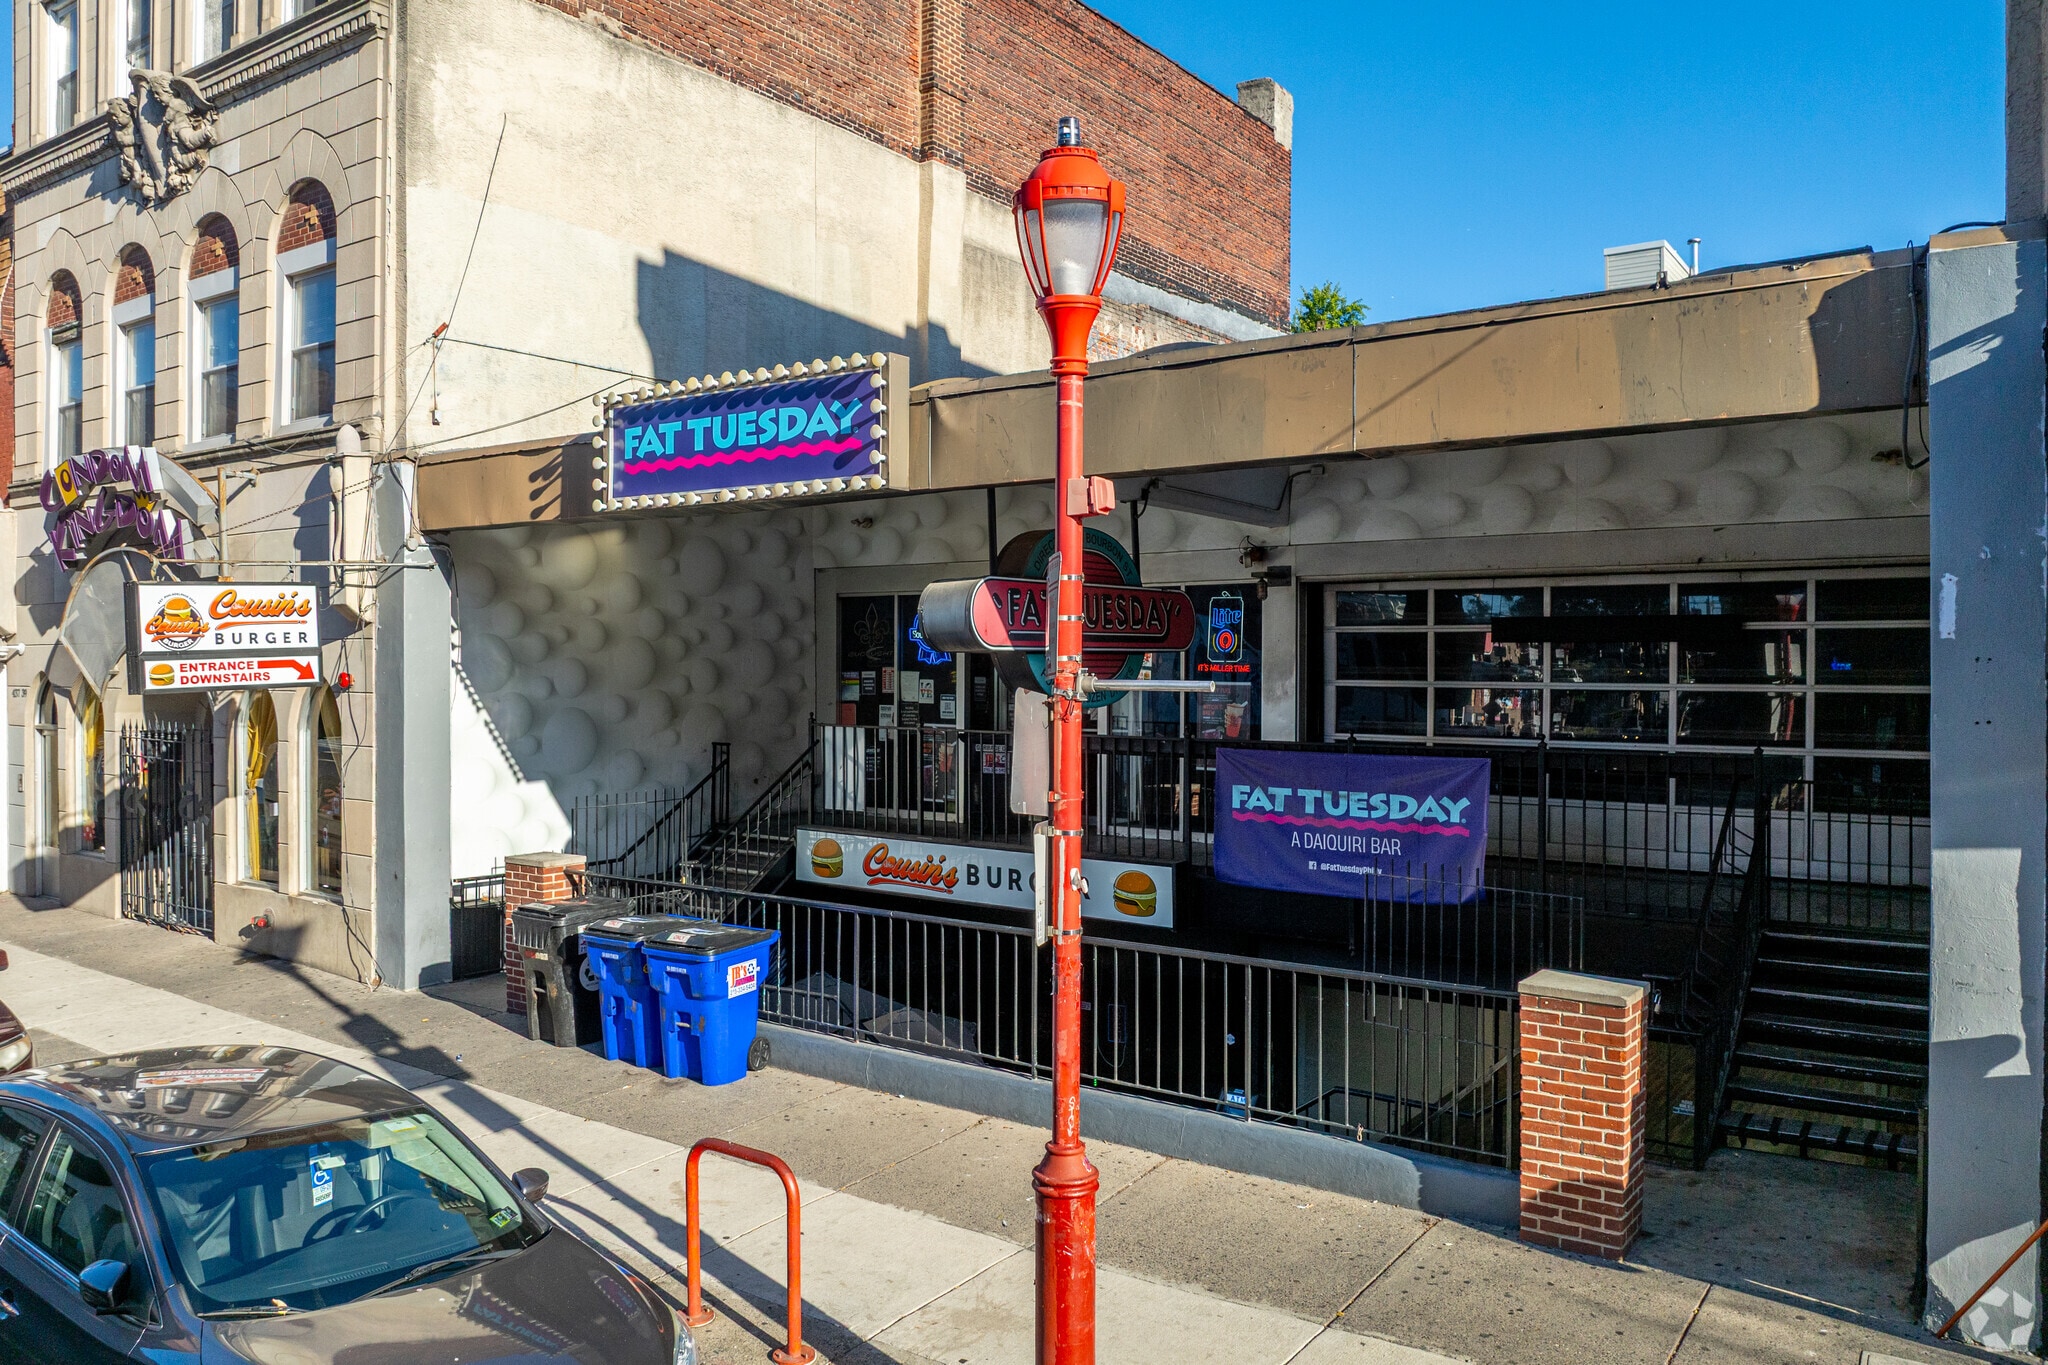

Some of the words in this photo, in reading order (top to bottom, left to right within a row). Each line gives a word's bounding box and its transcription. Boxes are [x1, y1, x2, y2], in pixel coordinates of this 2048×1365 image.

[624, 420, 683, 460] FAT
[687, 397, 863, 451] TUESDAY
[39, 445, 155, 513] CONDOM
[49, 486, 186, 573] KINGDOM
[1085, 532, 1124, 562] BOURBON
[1122, 561, 1134, 577] ST
[208, 588, 313, 620] Cousin's
[1007, 588, 1047, 628] FA
[1083, 592, 1174, 634] UESDAY
[144, 614, 211, 635] Cousin's
[1211, 607, 1242, 629] Lite
[162, 638, 194, 648] BURGER
[215, 631, 308, 645] BURGER
[179, 660, 255, 673] ENTRANCE
[180, 671, 271, 685] DOWNSTAIRS
[1197, 663, 1209, 672] IT'S
[1210, 664, 1233, 672] MILLER
[1233, 664, 1251, 673] TIME
[1231, 784, 1292, 812] FAT
[1297, 788, 1471, 824] TUESDAY
[1291, 832, 1302, 848] A
[1304, 832, 1366, 853] DAIQUIRI
[1371, 837, 1402, 856] BAR
[862, 842, 960, 888] Cousin's
[1320, 862, 1383, 875] @FatTuesdayPhiy
